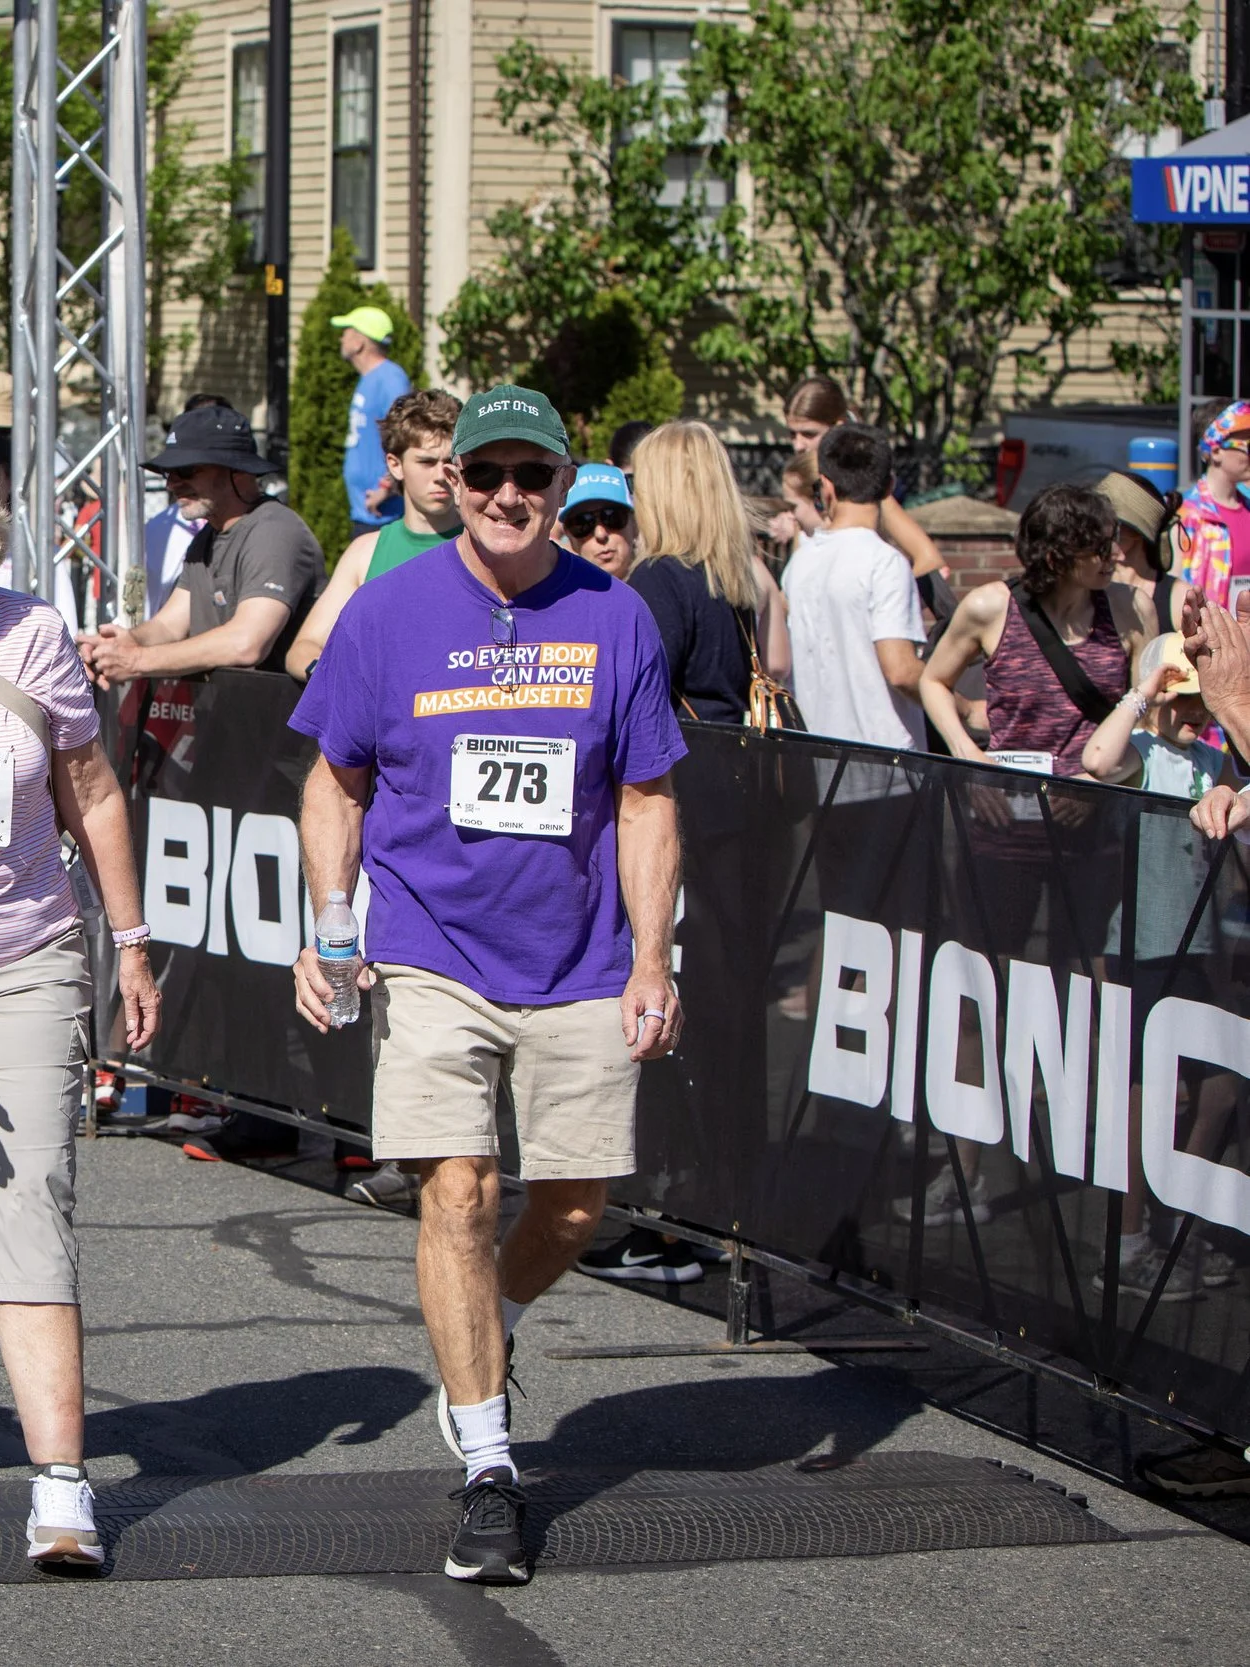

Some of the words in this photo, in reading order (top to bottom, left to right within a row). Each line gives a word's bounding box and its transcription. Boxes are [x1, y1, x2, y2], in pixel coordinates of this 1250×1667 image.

[1165, 164, 1250, 213] VPNE
[477, 400, 511, 418] EAST
[513, 400, 540, 417] OTIS
[578, 474, 622, 487] BUZZ
[448, 651, 475, 669] SO
[477, 646, 540, 666] EVERY
[541, 645, 596, 666] BODY
[491, 667, 533, 686] CAN
[537, 666, 595, 685] MOVE
[419, 686, 586, 714] MASSACHUSETTS
[466, 738, 548, 754] BIONIC
[477, 760, 548, 805] 273
[459, 818, 483, 826] FOOD
[499, 821, 524, 829] DRINK
[539, 823, 565, 831] DRINK
[145, 797, 370, 968] BIO
[808, 910, 1250, 1236] BIONIC
